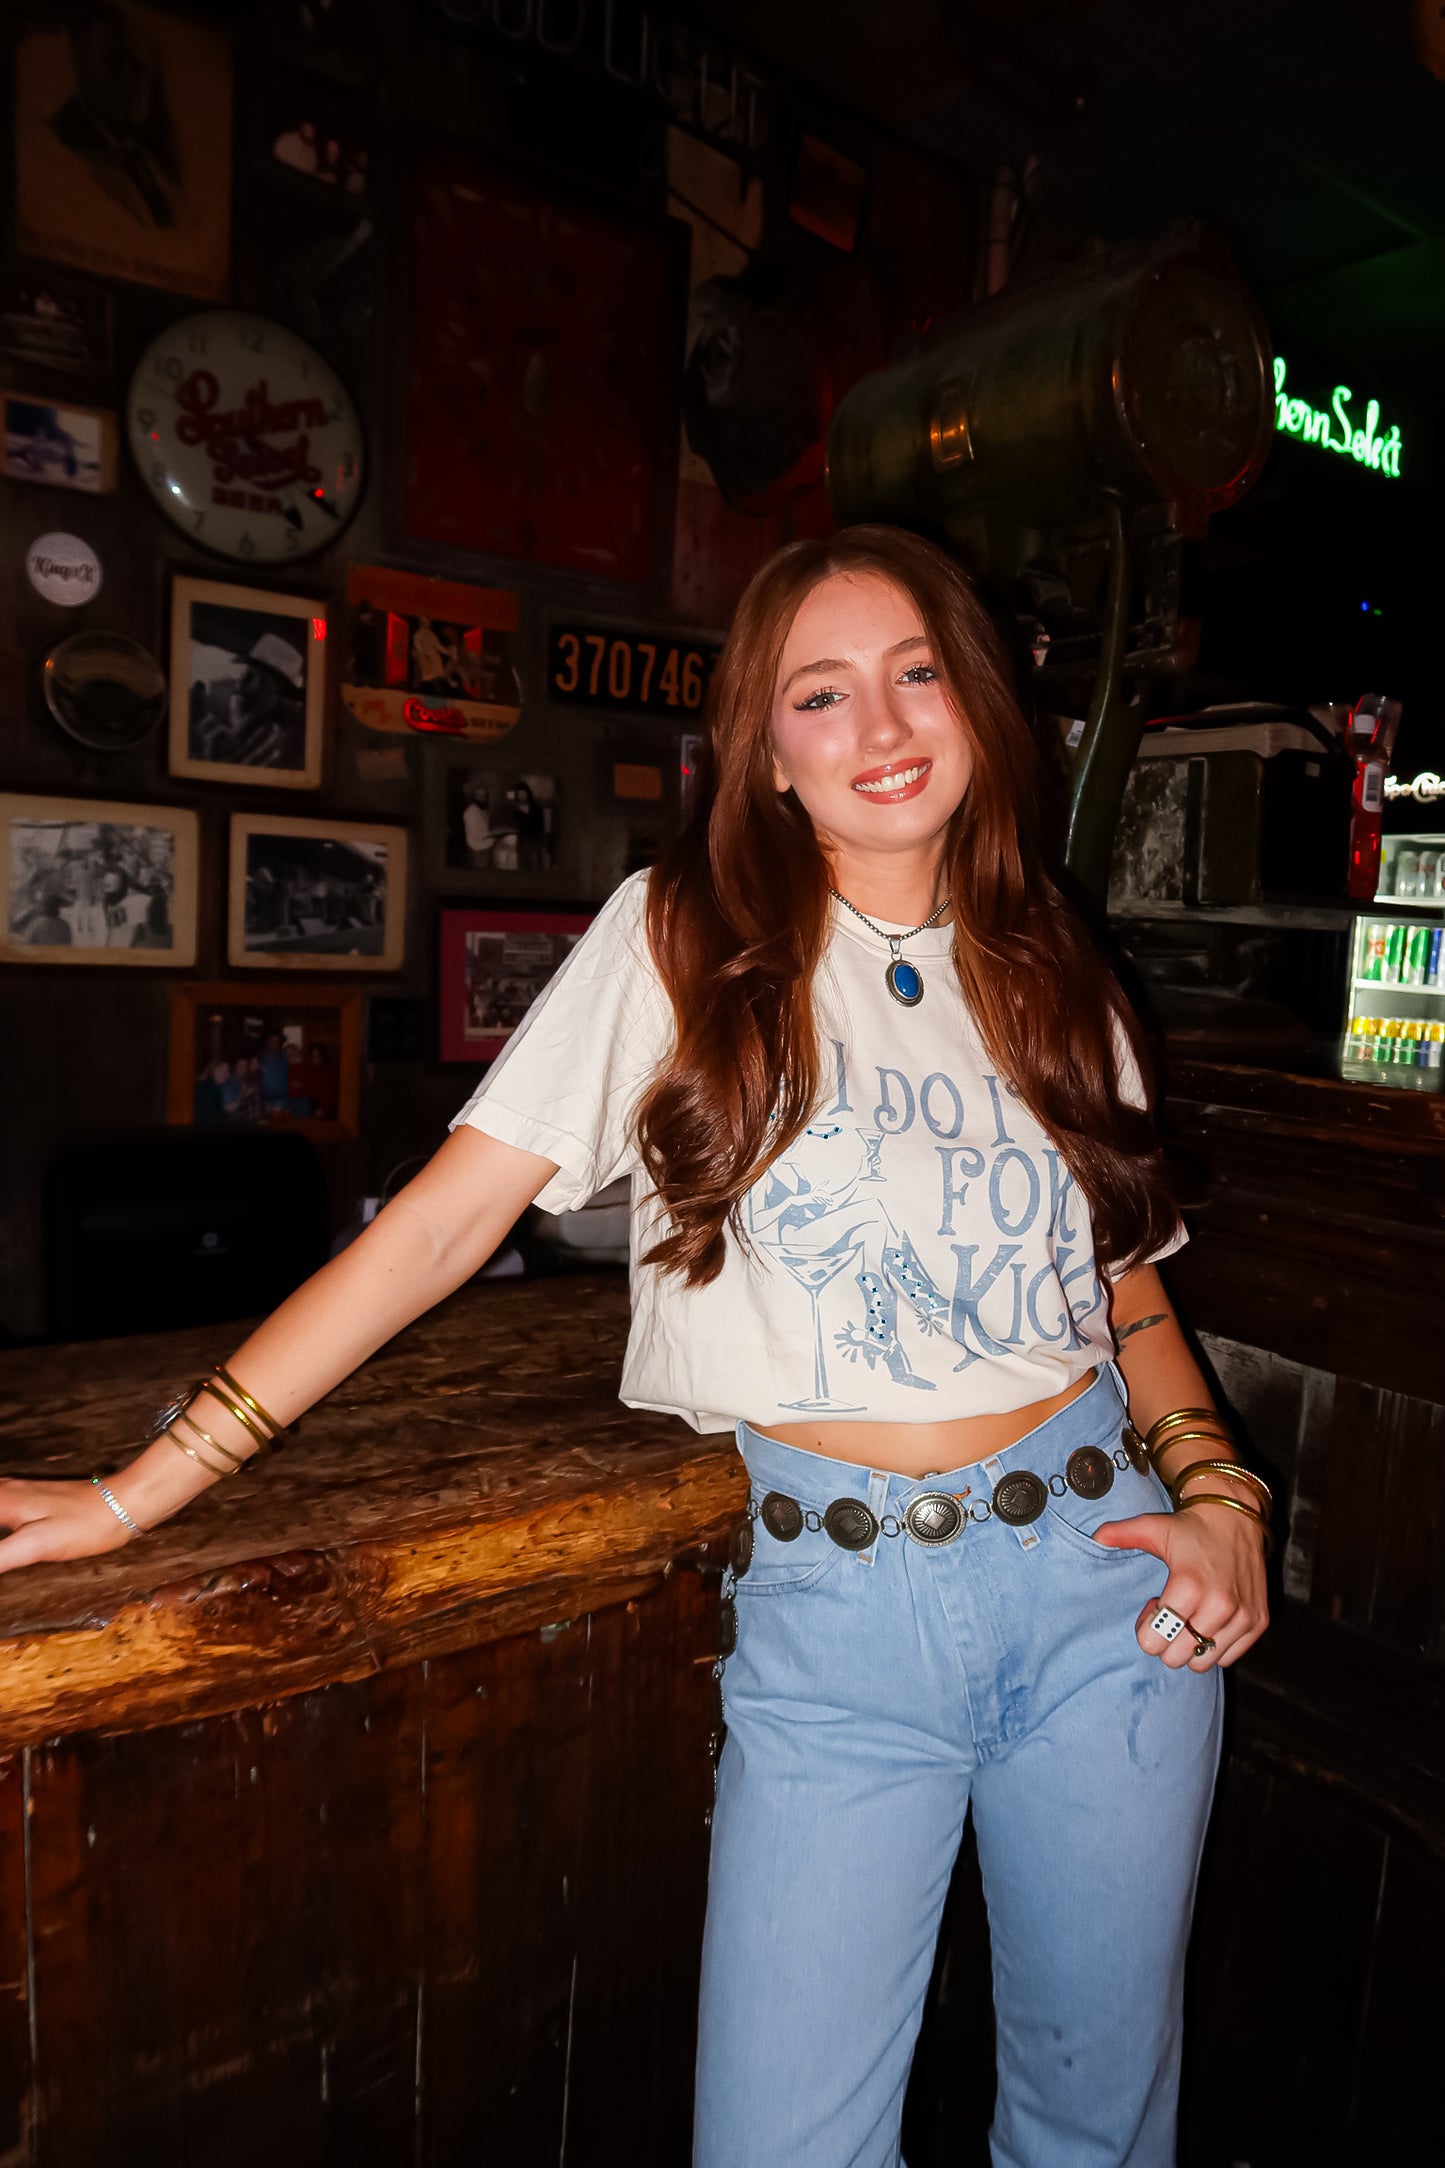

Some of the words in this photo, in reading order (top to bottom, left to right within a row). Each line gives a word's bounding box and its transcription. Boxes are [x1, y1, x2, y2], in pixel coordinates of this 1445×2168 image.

[188, 333, 208, 354] 11
[240, 328, 265, 353] 12
[138, 407, 156, 433] 9
[193, 510, 206, 532] 7
[286, 526, 299, 551] 5
[555, 632, 705, 710] 370746
[827, 1038, 853, 1116] I
[873, 1065, 965, 1139] DO
